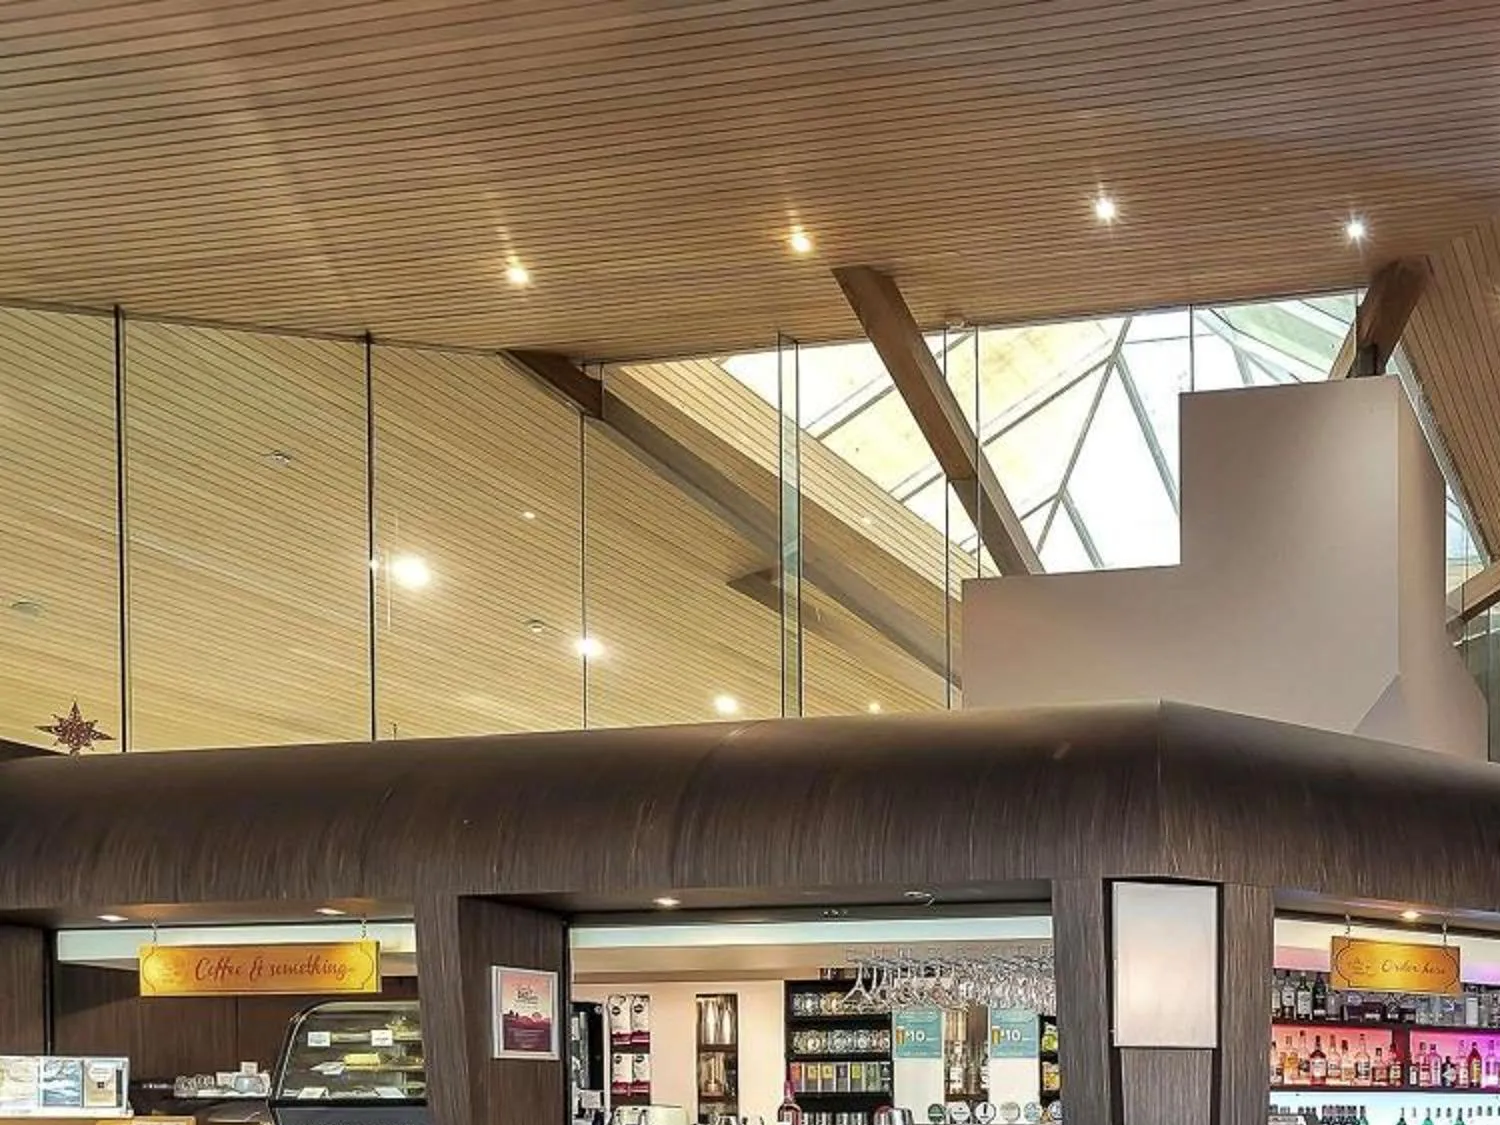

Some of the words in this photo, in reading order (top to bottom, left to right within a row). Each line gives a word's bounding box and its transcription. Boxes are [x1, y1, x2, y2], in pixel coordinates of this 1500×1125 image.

[194, 956, 242, 982] Coffee
[269, 954, 348, 981] something
[1380, 959, 1418, 973] Order
[1422, 959, 1446, 975] here
